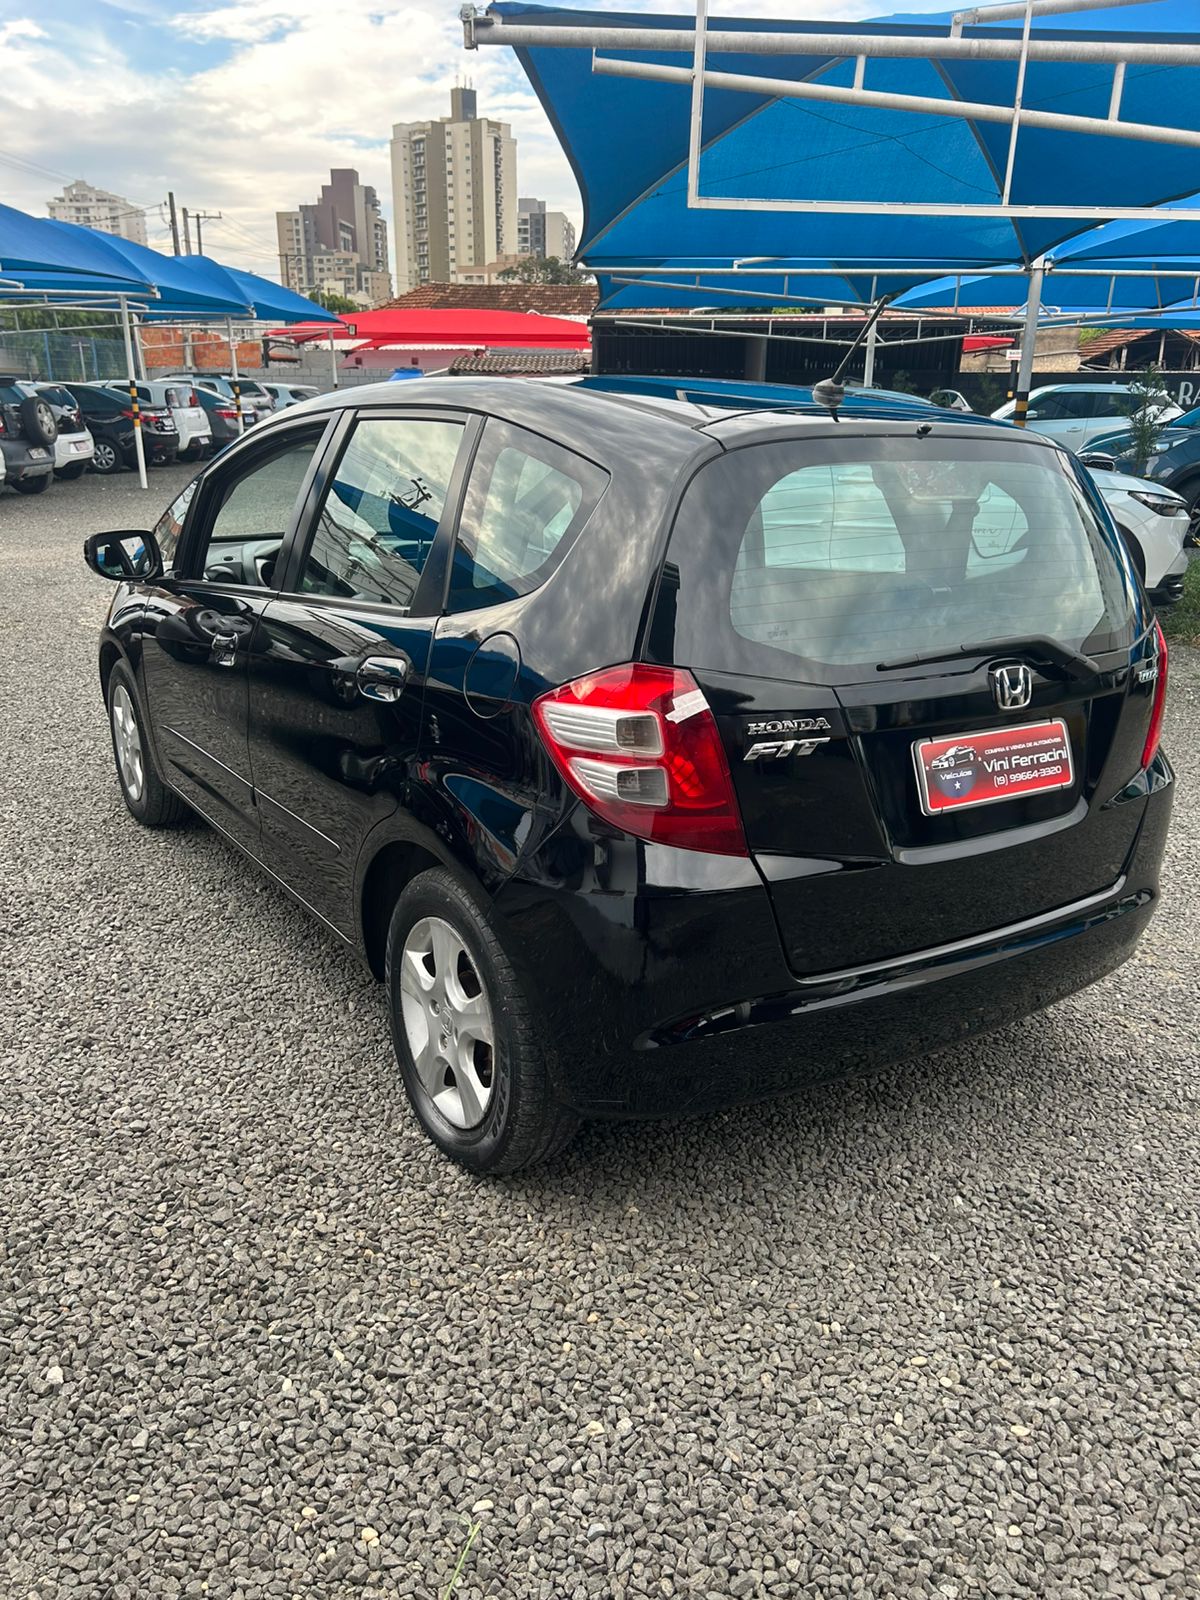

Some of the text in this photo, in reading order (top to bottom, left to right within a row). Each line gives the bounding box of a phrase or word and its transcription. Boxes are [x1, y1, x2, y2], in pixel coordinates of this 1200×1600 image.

[747, 717, 832, 735] HONDA
[743, 737, 831, 760] FIT
[983, 746, 1068, 773] Vini Ferracini
[984, 747, 1006, 755] COMPRA
[1009, 743, 1026, 751] VENDA
[993, 765, 1062, 788] (19) 99664-3320
